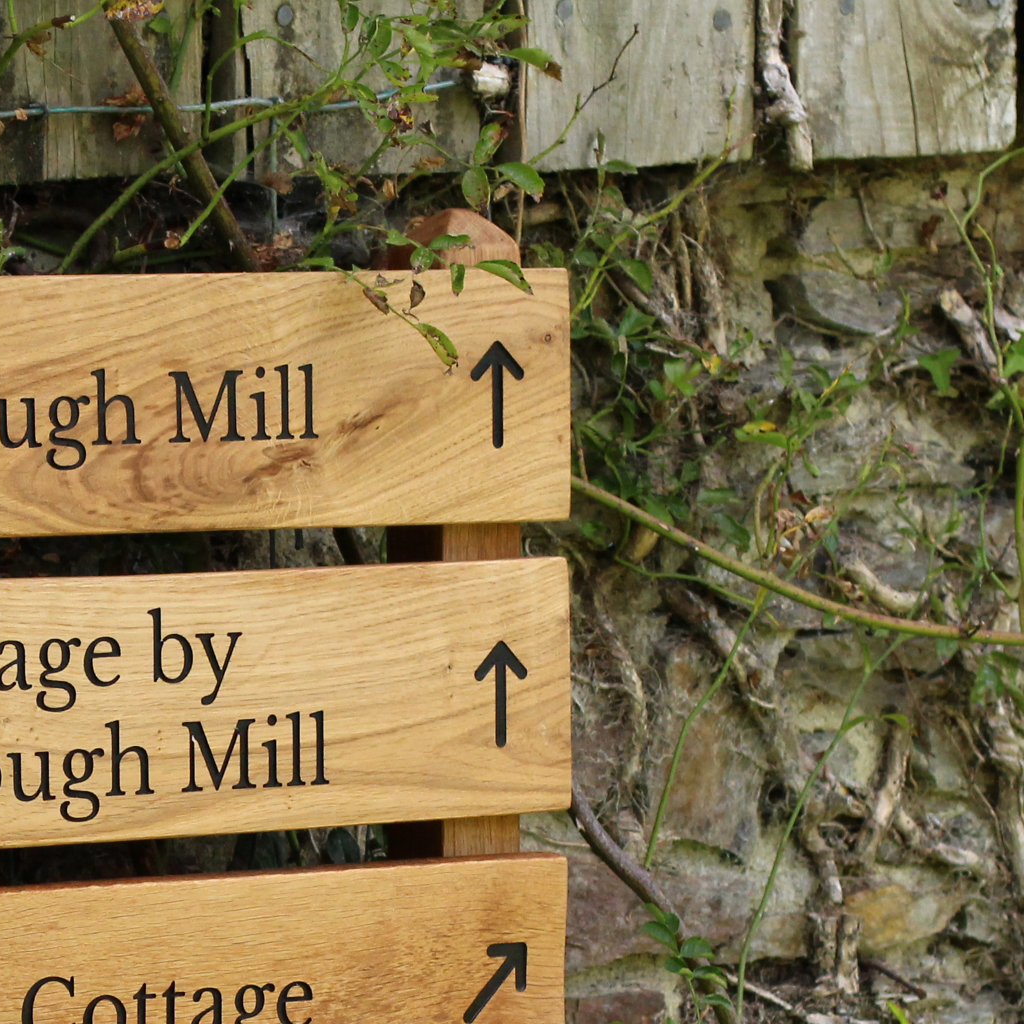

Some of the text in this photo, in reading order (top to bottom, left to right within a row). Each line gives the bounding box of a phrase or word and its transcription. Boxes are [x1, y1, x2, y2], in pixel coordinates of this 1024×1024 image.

[168, 362, 319, 444] Mill
[147, 607, 243, 706] by
[182, 710, 330, 793] Mill
